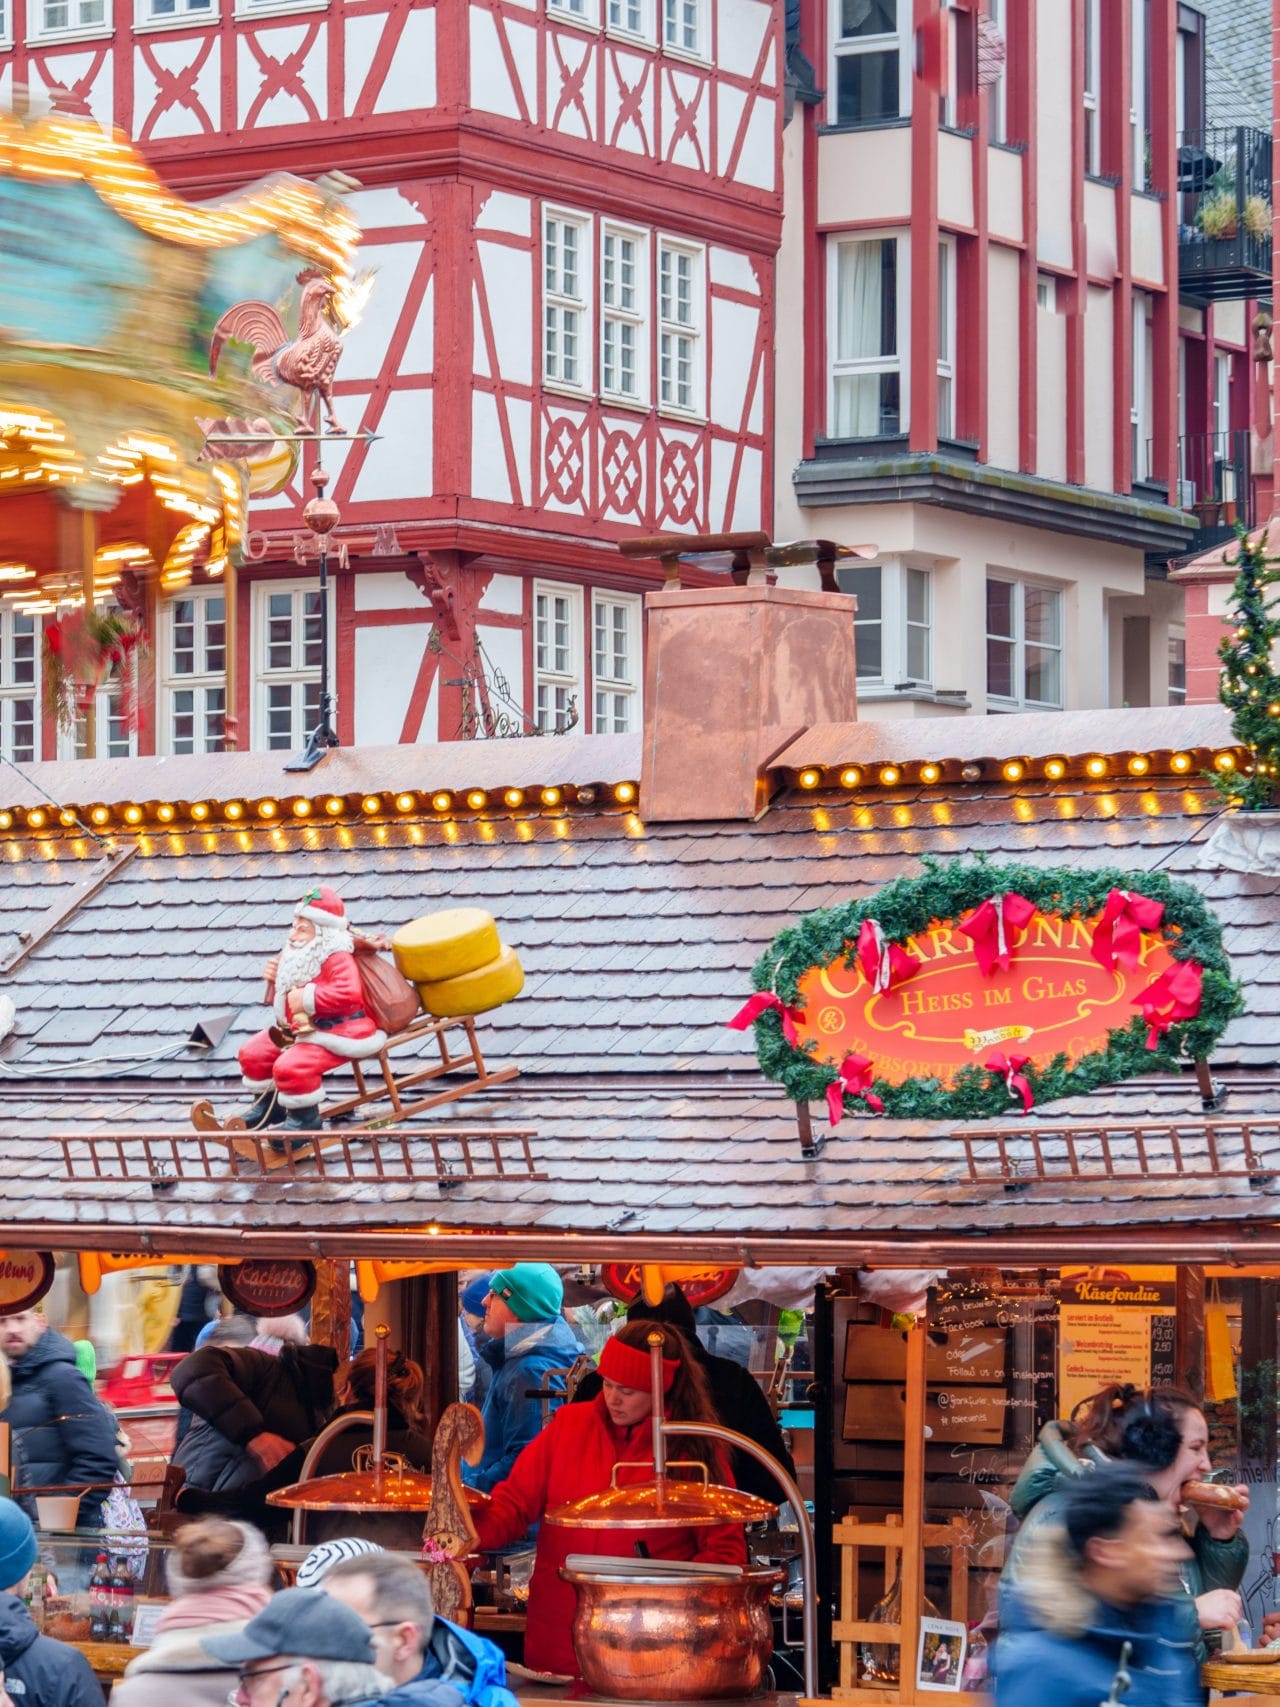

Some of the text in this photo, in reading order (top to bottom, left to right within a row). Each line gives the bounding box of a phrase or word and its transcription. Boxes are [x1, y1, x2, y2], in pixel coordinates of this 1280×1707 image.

[900, 976, 1087, 1016] HEISS IM GLAS
[1075, 1282, 1160, 1304] Käsefondue
[946, 1366, 975, 1377] Follow
[980, 1369, 990, 1377] us
[994, 1369, 1005, 1377] on
